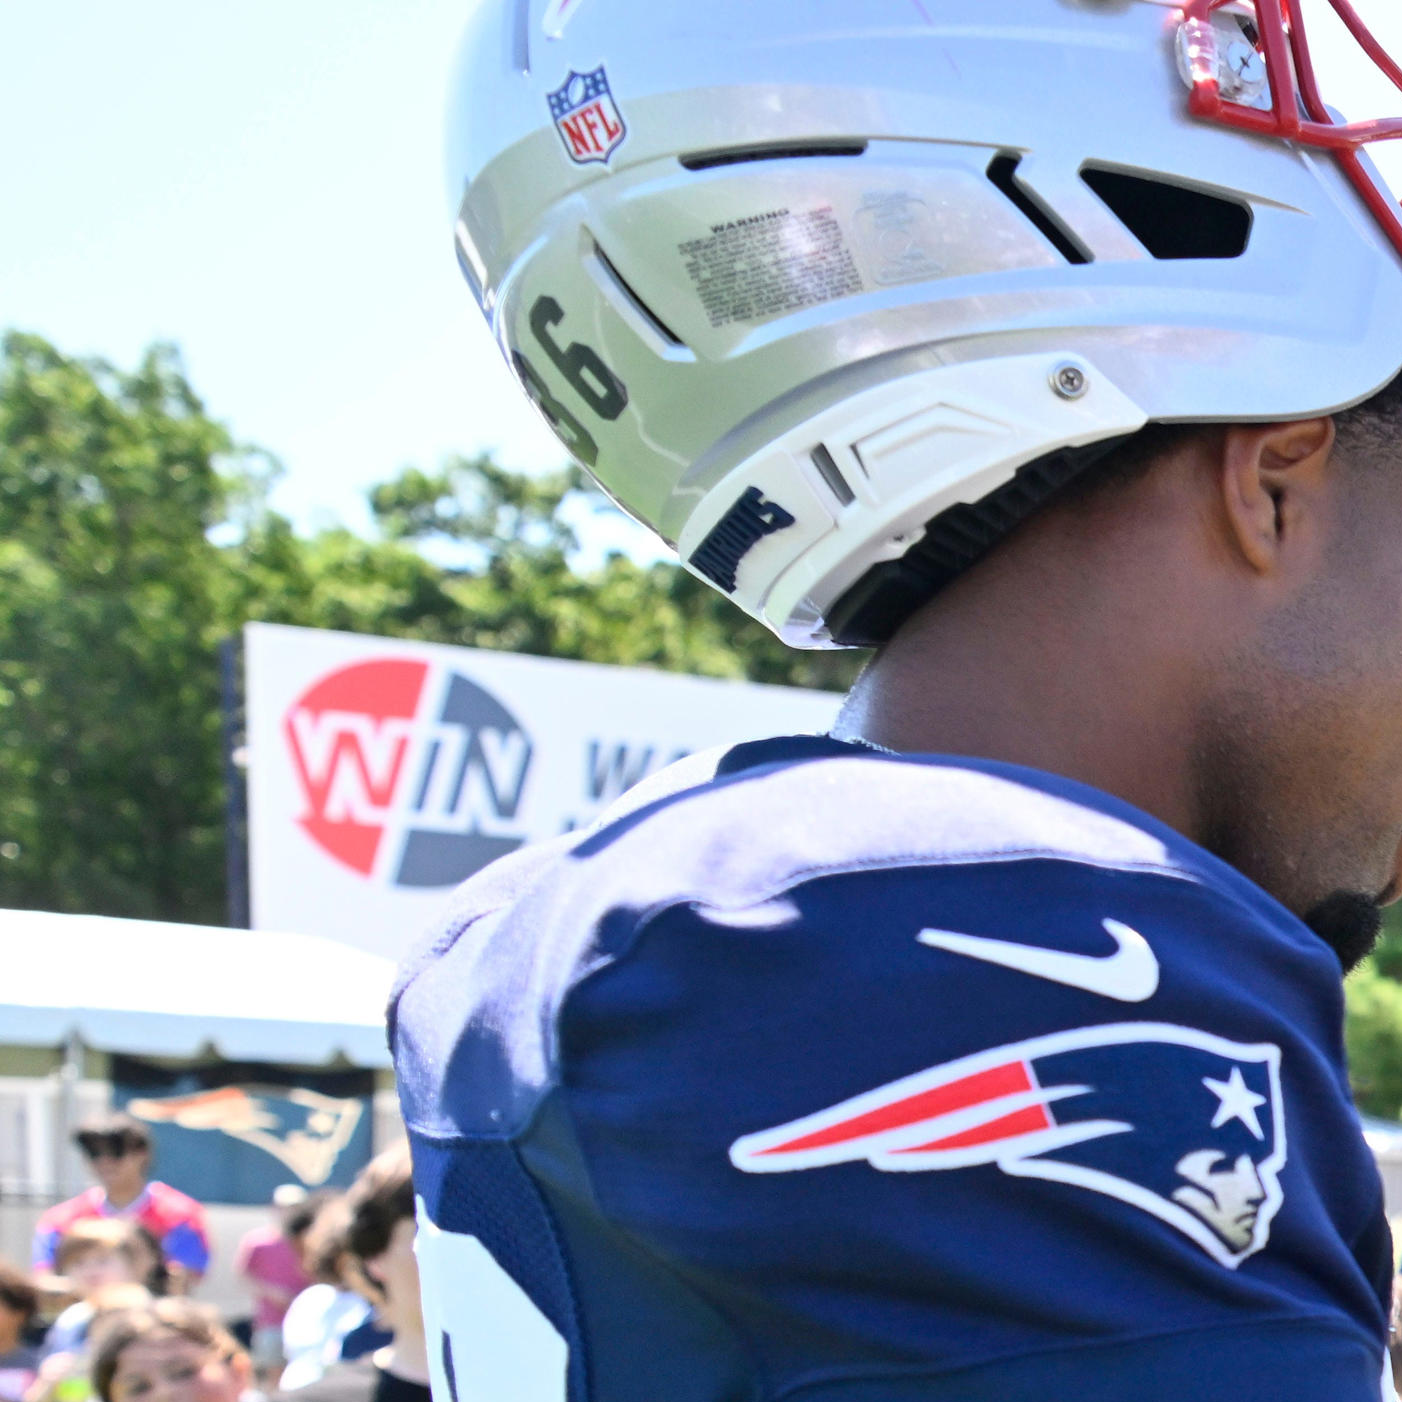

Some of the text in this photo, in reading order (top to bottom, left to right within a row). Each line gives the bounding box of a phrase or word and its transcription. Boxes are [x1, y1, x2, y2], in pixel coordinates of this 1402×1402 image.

[562, 102, 621, 155] NFL
[710, 208, 790, 234] WARNING
[285, 705, 534, 839] WIN
